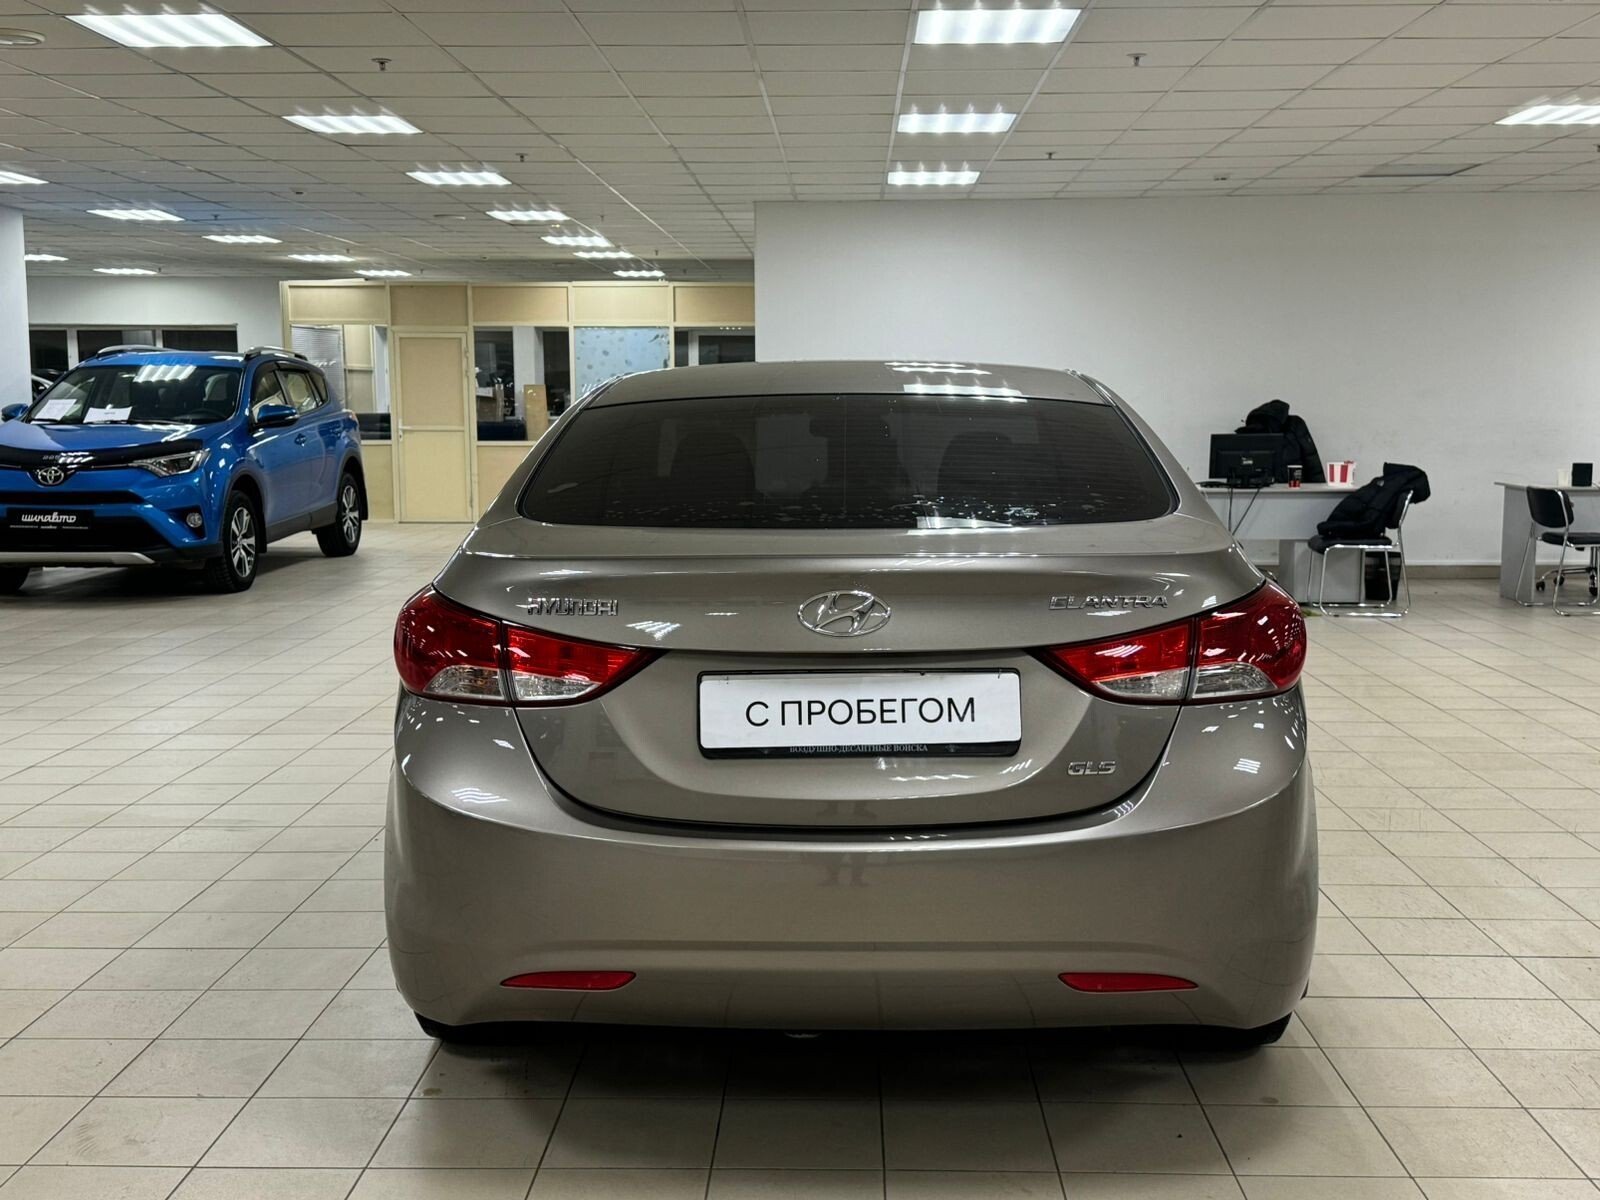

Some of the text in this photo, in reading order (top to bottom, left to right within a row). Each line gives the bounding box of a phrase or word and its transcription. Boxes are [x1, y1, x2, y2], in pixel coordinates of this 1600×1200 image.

[527, 597, 618, 616] HYUNDAI
[1049, 595, 1168, 610] ELANTRA
[746, 697, 976, 727] С ПРОБЕГОМ
[1067, 760, 1117, 775] GLS
